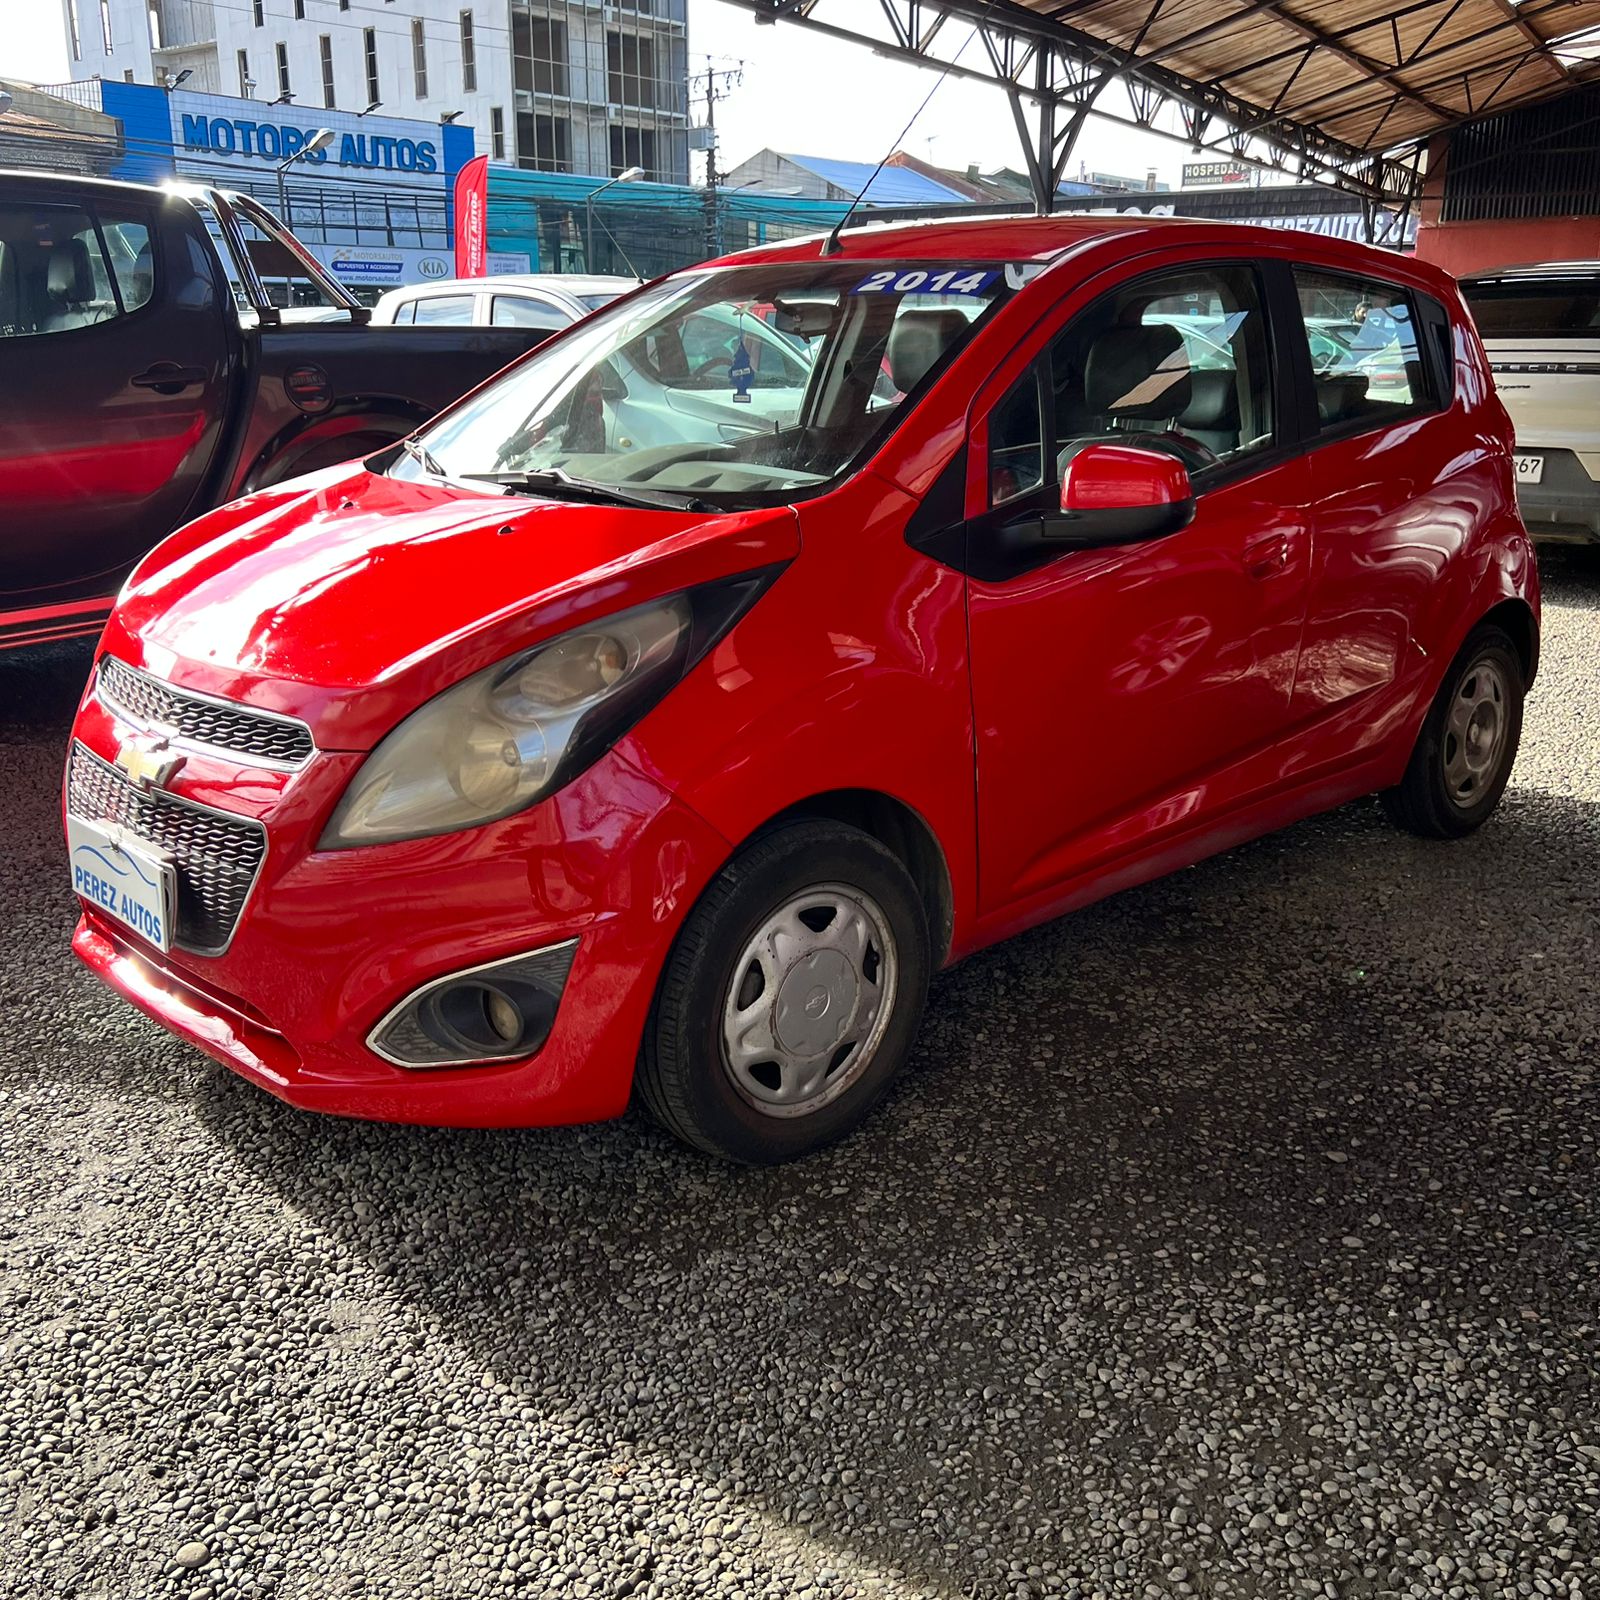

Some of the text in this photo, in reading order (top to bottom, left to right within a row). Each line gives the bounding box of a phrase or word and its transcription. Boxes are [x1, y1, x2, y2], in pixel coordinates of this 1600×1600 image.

[181, 114, 437, 173] MOTORS AUTOS
[353, 251, 403, 261] MOTORSAUTOS
[337, 262, 365, 270] REPUESTOS
[423, 261, 444, 274] KIA
[857, 270, 988, 293] 2014
[1491, 364, 1578, 372] RSCHE
[75, 865, 162, 943] PEREZ AUTOS
